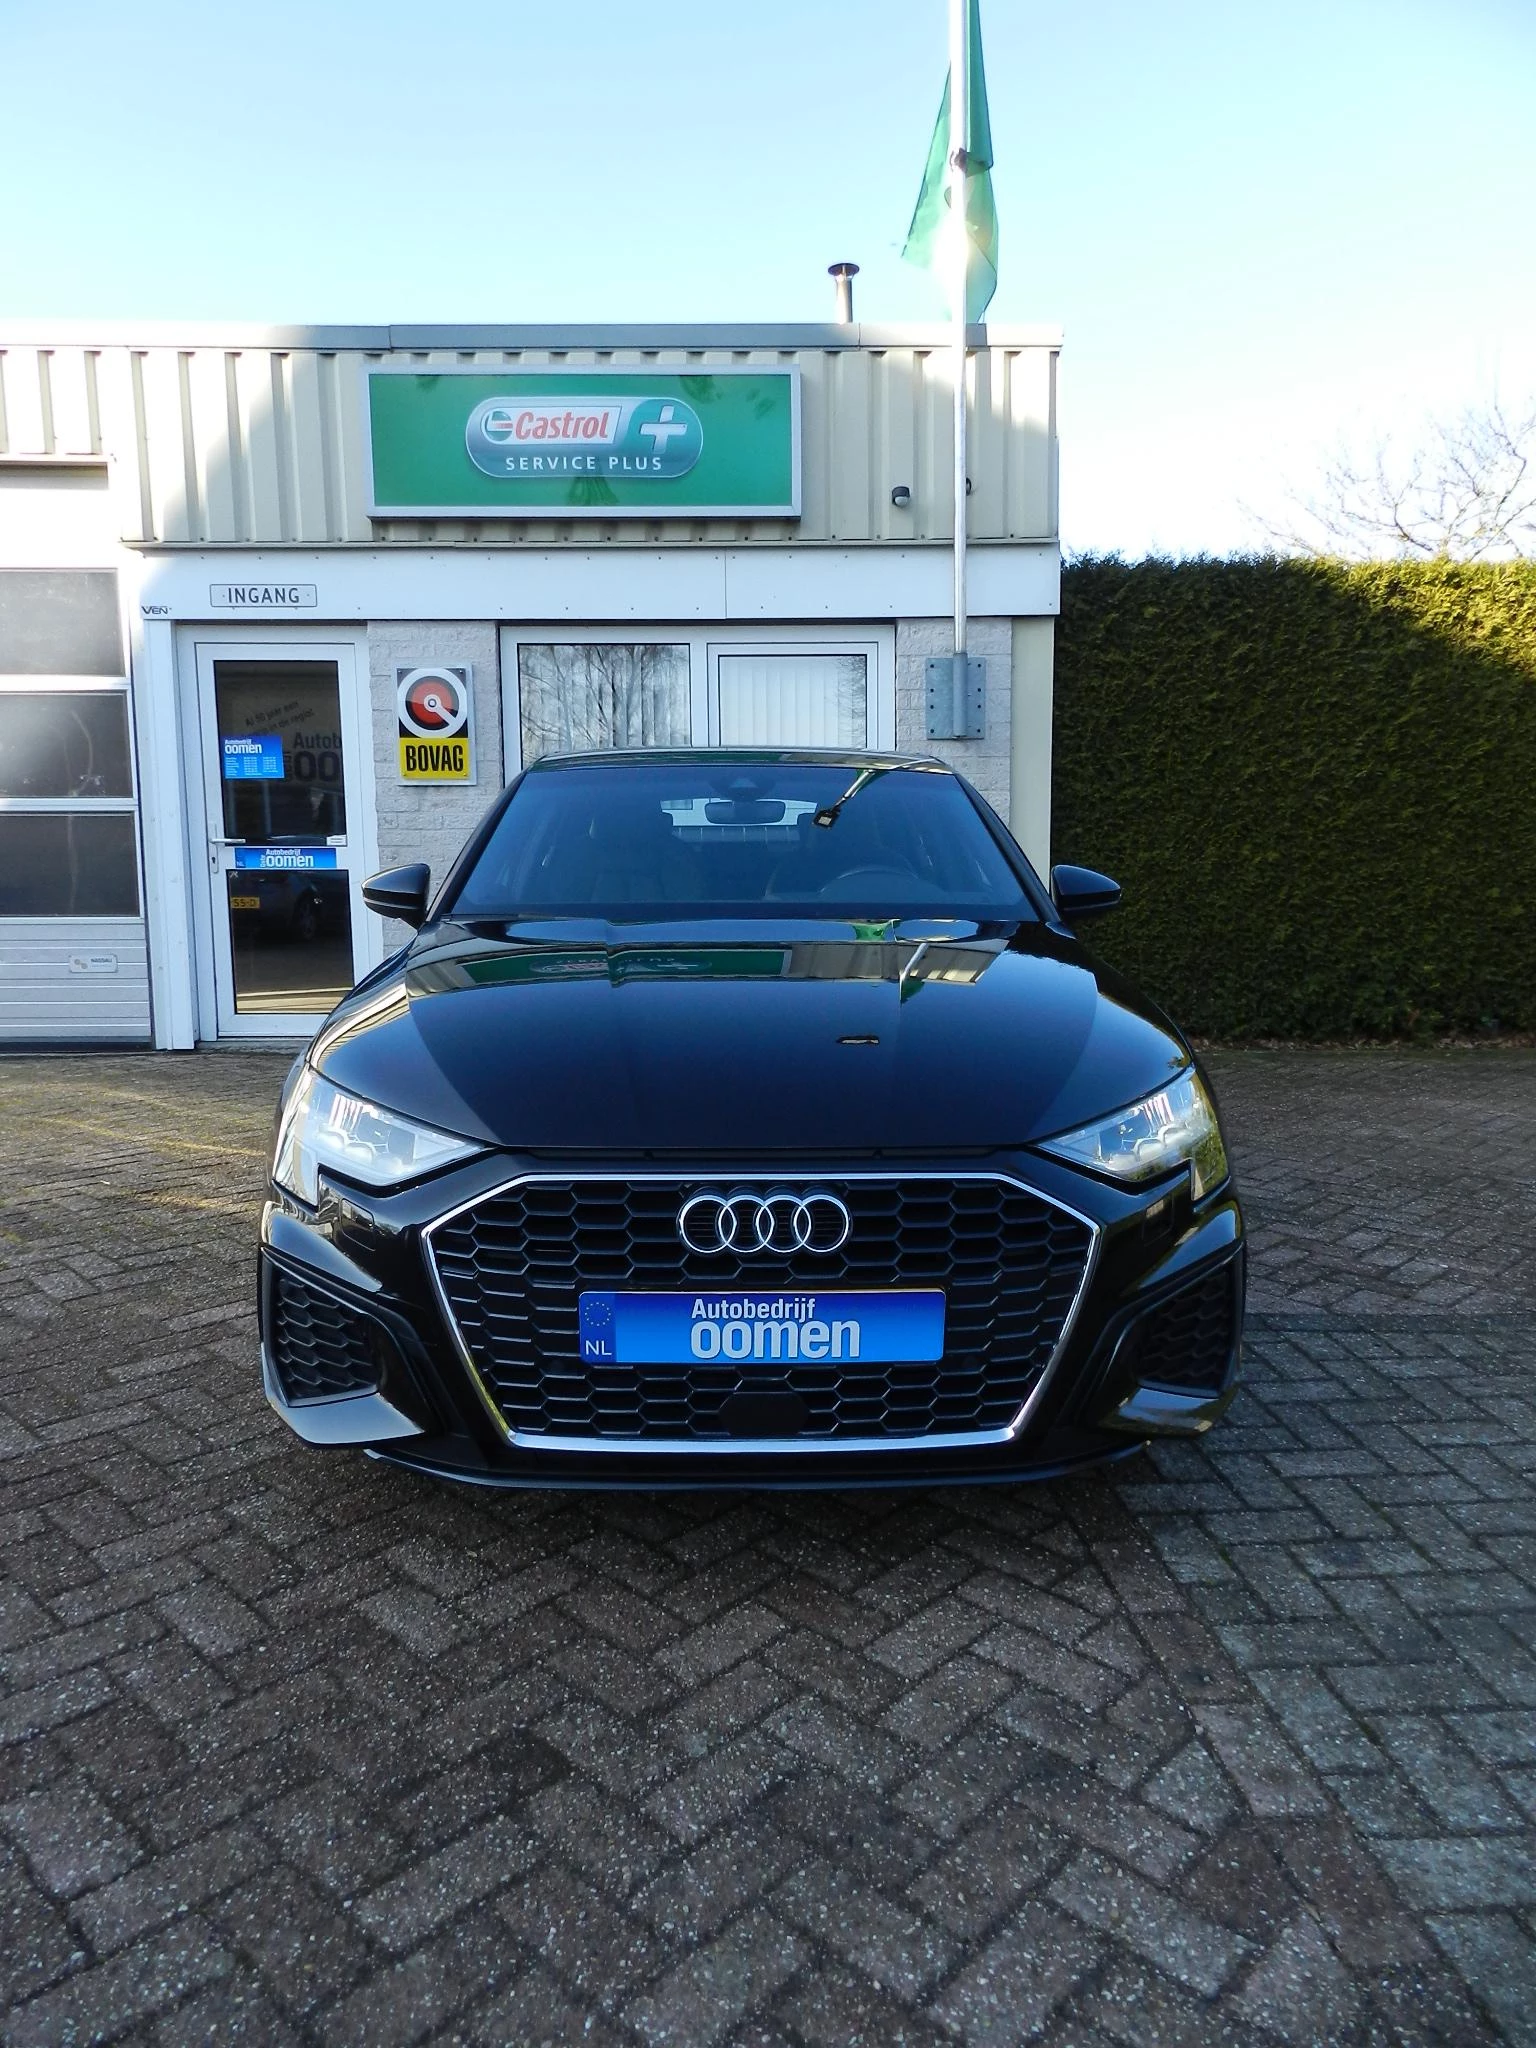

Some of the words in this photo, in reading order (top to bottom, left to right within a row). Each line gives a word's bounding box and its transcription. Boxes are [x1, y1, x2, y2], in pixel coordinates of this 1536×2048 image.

[515, 411, 610, 440] Castrol
[505, 455, 597, 471] SERVICE
[608, 456, 663, 471] PLUS
[228, 587, 300, 604] INGANG
[225, 744, 262, 754] oomen
[405, 745, 464, 772] BOVAG
[266, 848, 301, 856] Autobedrijf
[266, 855, 314, 868] oomen
[691, 1298, 816, 1322] Autobedrijf
[585, 1340, 612, 1356] NL
[690, 1320, 861, 1360] oomen
